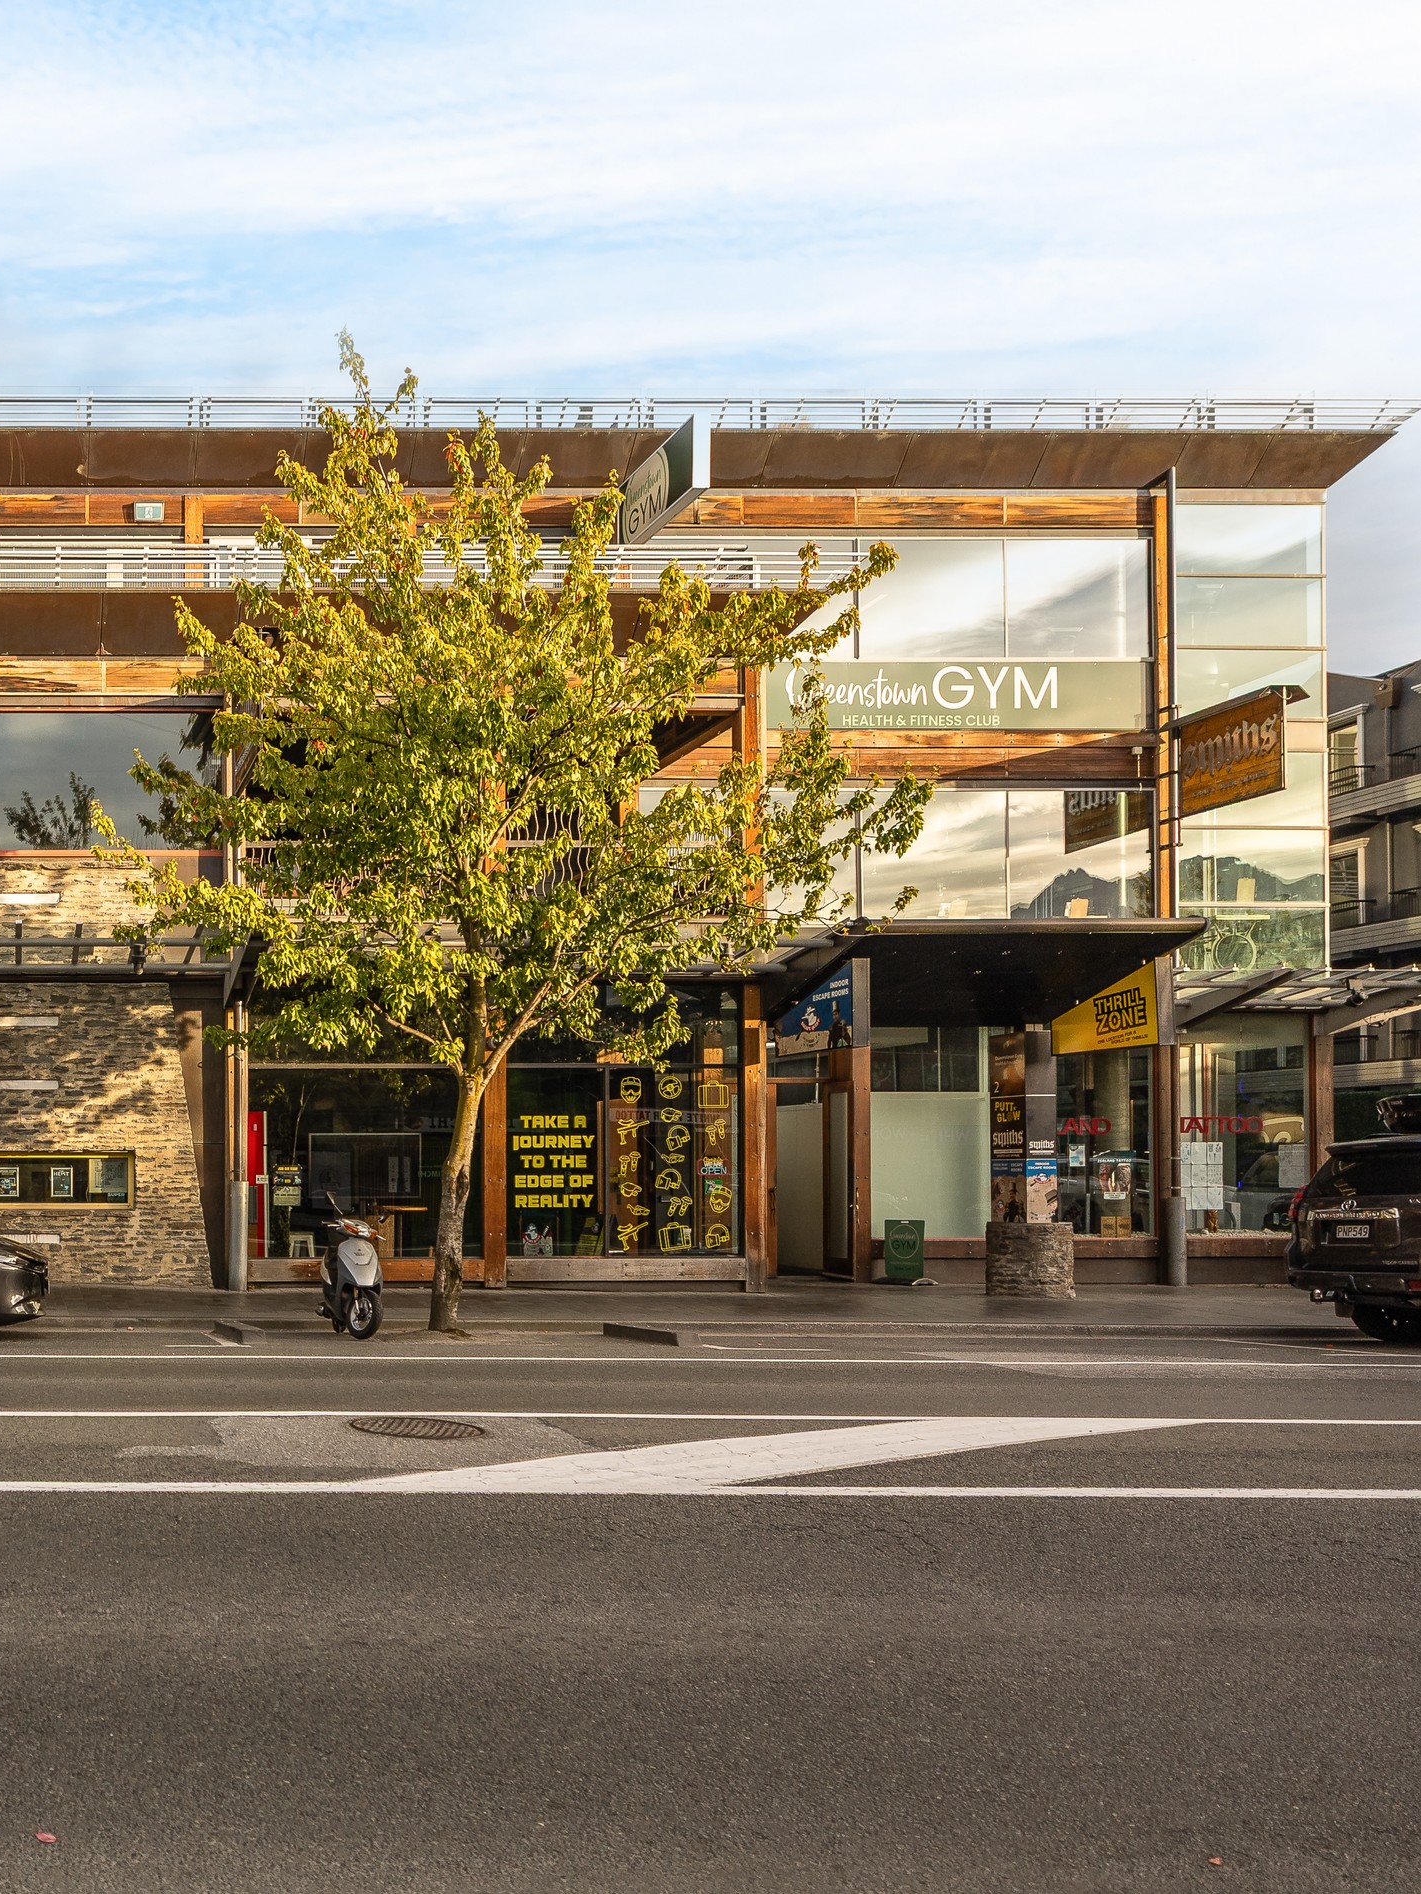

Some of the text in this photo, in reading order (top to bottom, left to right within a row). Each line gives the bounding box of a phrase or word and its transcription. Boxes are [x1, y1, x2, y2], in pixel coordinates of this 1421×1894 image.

[629, 485, 662, 535] GYM
[932, 665, 1058, 710] GYM
[842, 714, 1001, 727] HEALTH & FITNESS CLUB
[1182, 713, 1278, 780] smiths
[829, 978, 849, 989] INDOOR
[812, 988, 849, 1002] ESCAPE ROOMS
[1094, 989, 1144, 1014] THRILL
[1097, 1004, 1146, 1033] ZONE
[994, 1081, 1000, 1093] 2
[994, 1101, 1014, 1112] PUTT
[520, 1115, 569, 1129] TAKE
[573, 1115, 587, 1129] A
[1057, 1116, 1264, 1135] AND TATTOO
[512, 1135, 595, 1151] JOURNEY
[992, 1129, 1024, 1147] smiths
[1028, 1139, 1055, 1151] smiths
[520, 1155, 587, 1169] TO THE
[700, 1166, 727, 1175] OPEN
[514, 1174, 594, 1188] EDGE OF
[514, 1194, 594, 1208] REALITY
[1337, 1226, 1369, 1237] PNP549
[892, 1240, 916, 1250] GYM
